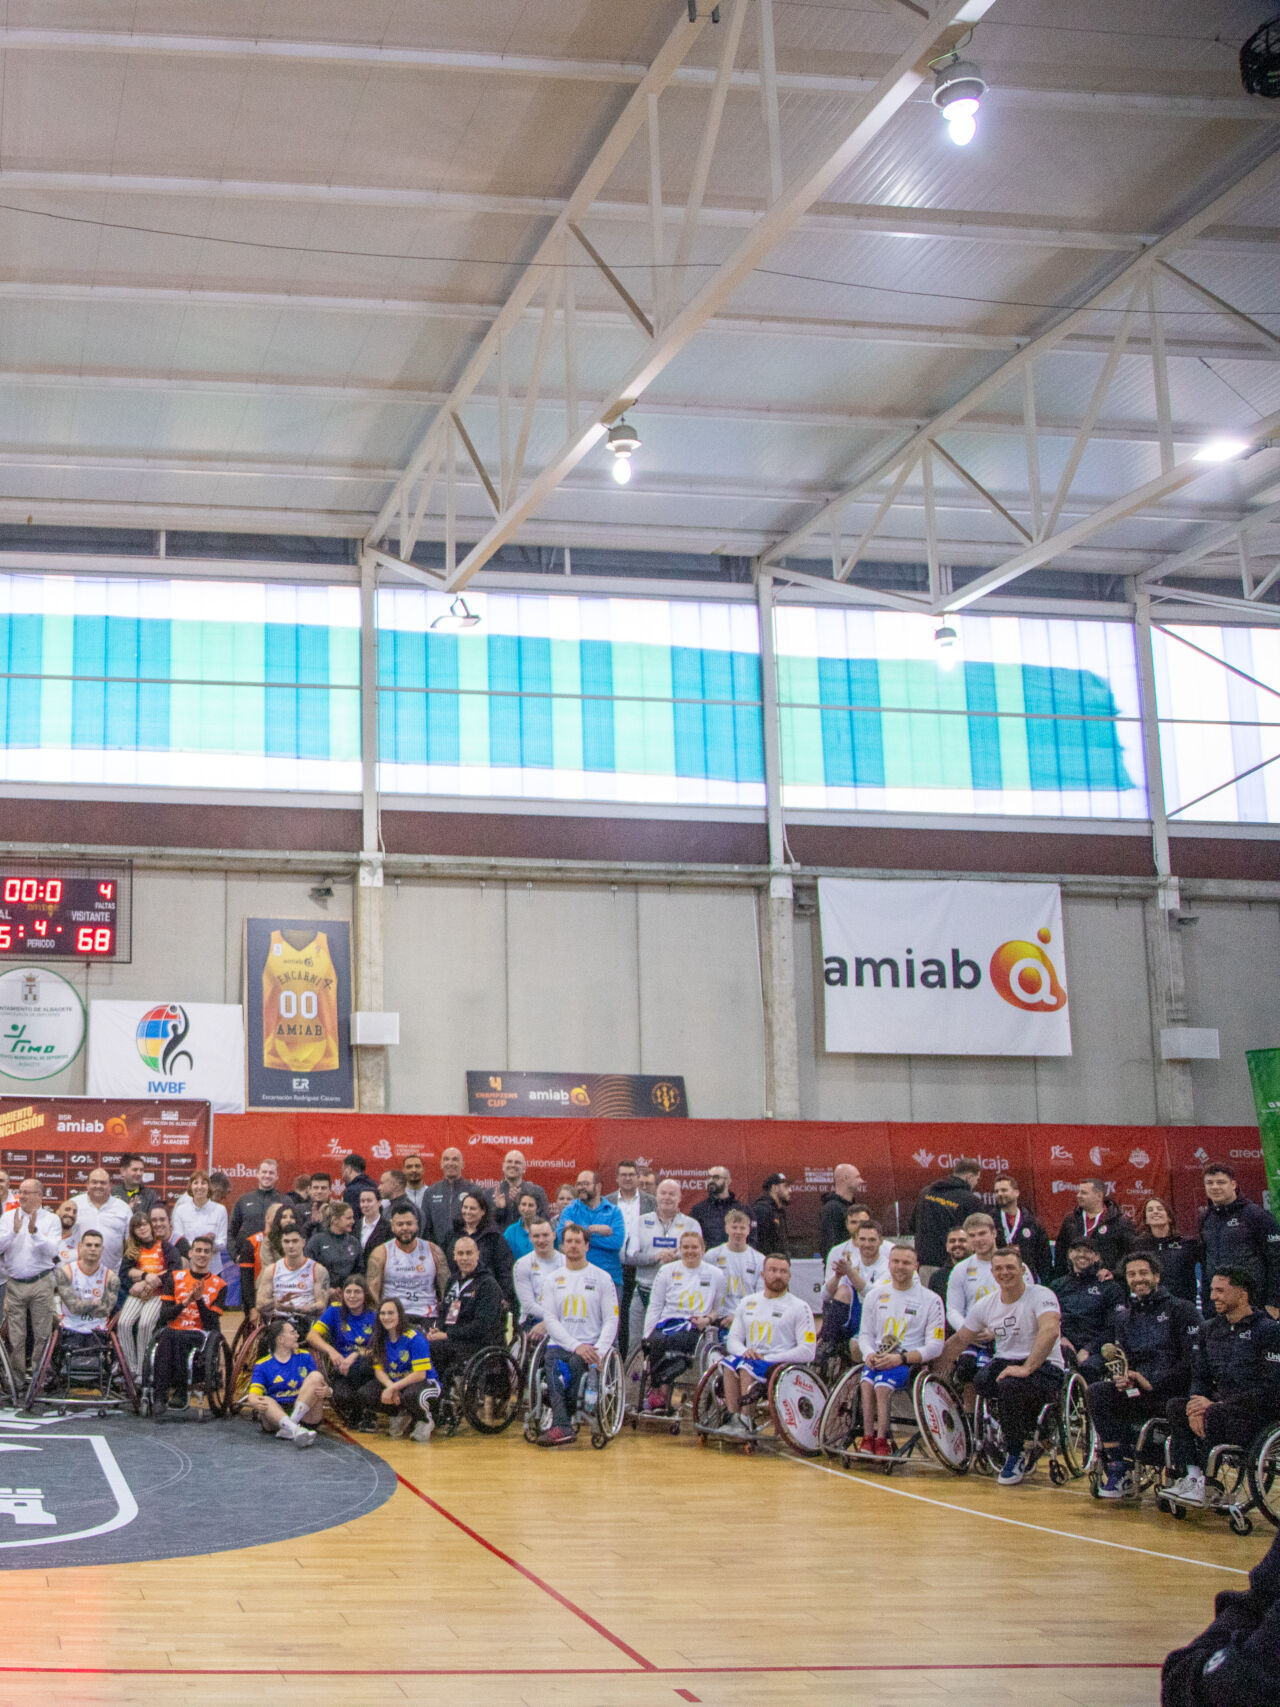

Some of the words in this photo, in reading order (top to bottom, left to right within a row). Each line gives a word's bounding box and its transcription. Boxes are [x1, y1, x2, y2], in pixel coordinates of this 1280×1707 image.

[98, 882, 113, 900] 4
[71, 910, 111, 922] VISITANTE
[76, 927, 112, 952] 68
[824, 948, 982, 989] amiab
[279, 990, 318, 1020] 00
[276, 1024, 324, 1036] AMIAB
[148, 1081, 186, 1094] IWBF
[528, 1088, 570, 1101] amiab
[56, 1119, 105, 1133] amiab
[481, 1135, 534, 1145] DECATHLON
[660, 1168, 709, 1178] Ayuntamien
